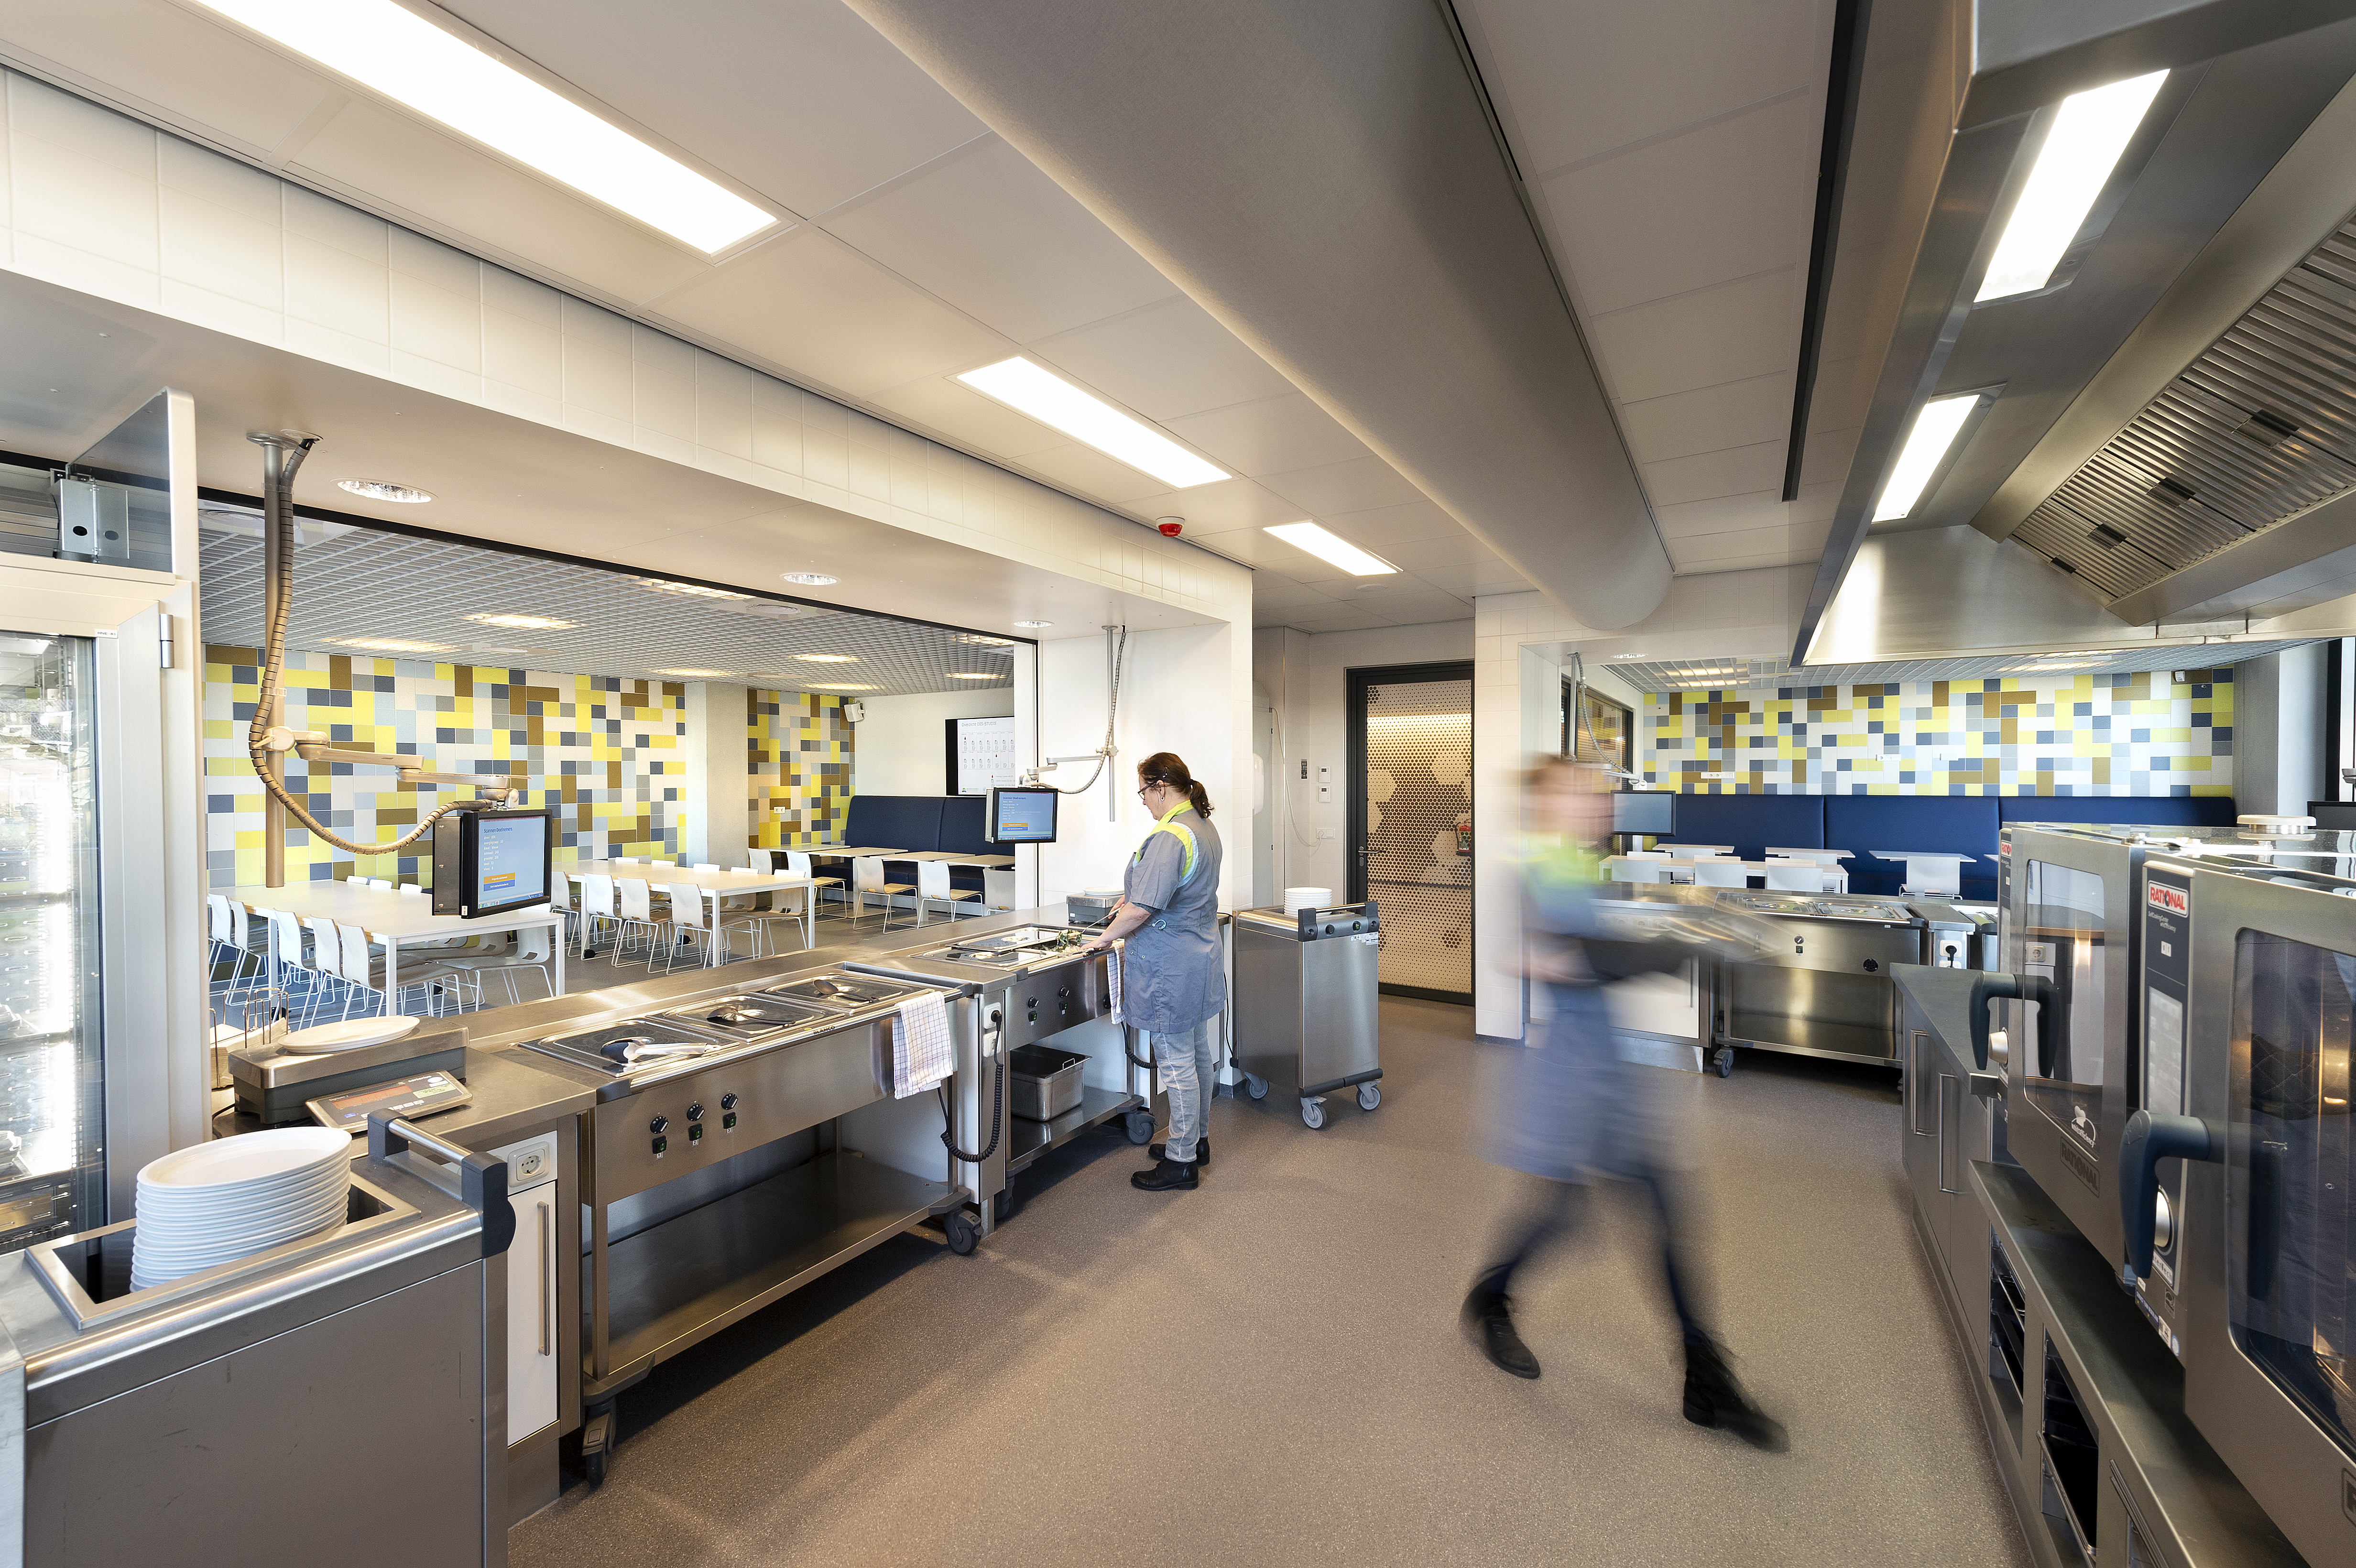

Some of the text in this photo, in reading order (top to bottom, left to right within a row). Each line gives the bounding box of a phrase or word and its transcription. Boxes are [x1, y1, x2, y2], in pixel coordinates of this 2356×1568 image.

[2150, 886, 2185, 911] RATIONAL
[814, 1026, 835, 1034] BLANCO
[2062, 1142, 2098, 1191] RATIONAL
